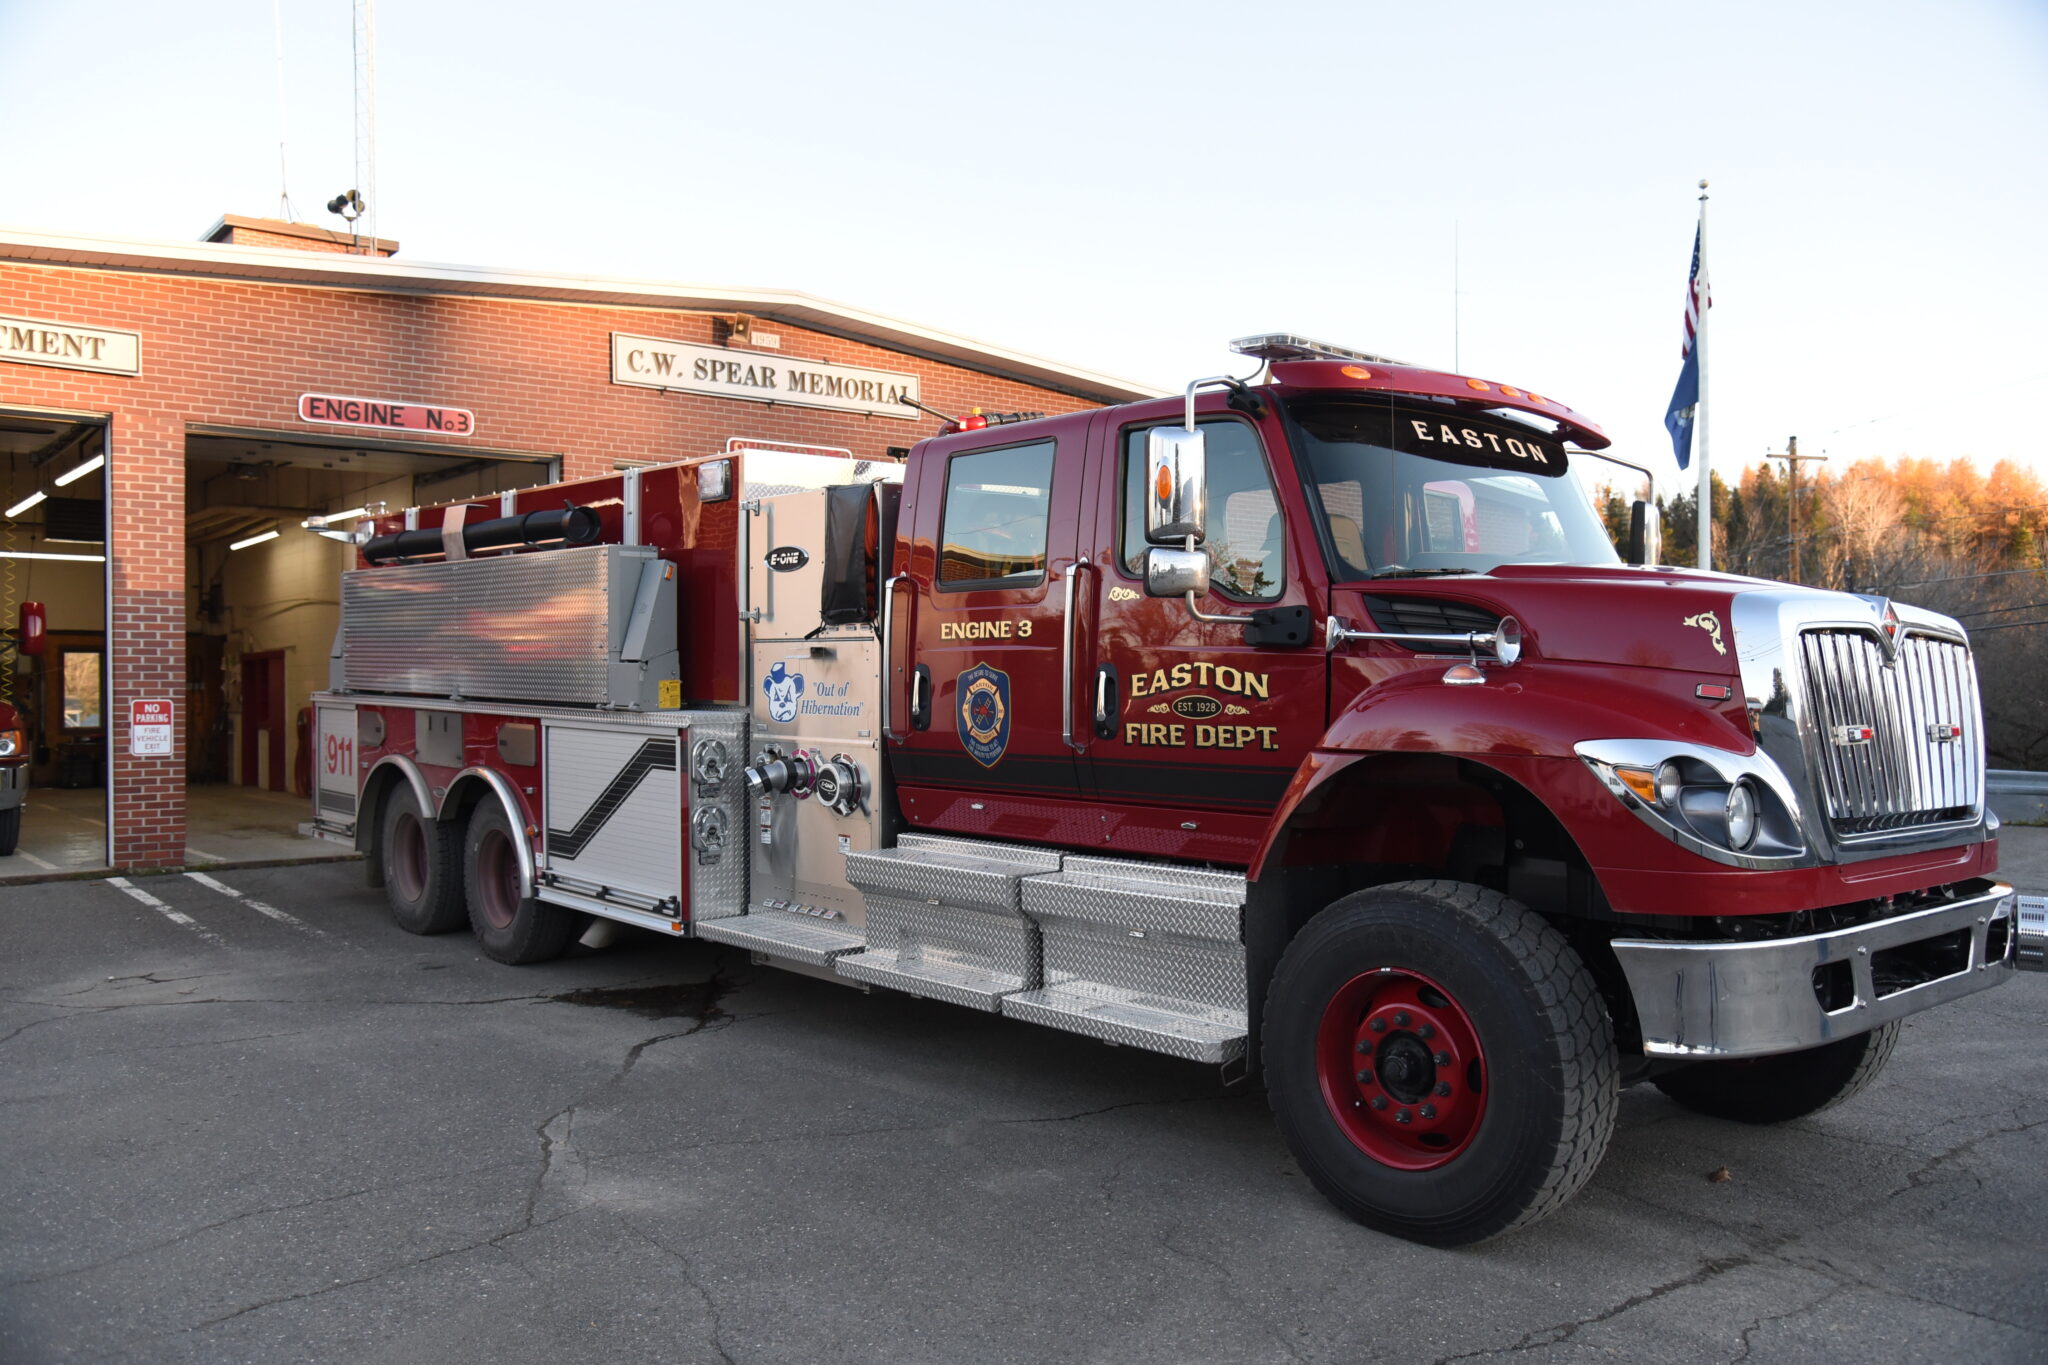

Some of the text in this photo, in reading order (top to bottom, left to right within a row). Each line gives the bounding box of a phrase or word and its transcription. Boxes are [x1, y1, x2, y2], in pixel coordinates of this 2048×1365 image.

[755, 334, 777, 347] 1959
[627, 349, 683, 378] C.W.
[693, 357, 778, 389] SPEAR
[309, 398, 405, 427] ENGINE
[1411, 420, 1549, 464] EASTON
[770, 551, 800, 566] E-ONE
[941, 620, 1033, 640] ENGINE 3
[838, 681, 850, 697] of
[1131, 661, 1269, 698] EASTON
[144, 703, 160, 713] NO
[1177, 701, 1216, 713] EST. 1928
[136, 713, 169, 723] PARKING
[1125, 722, 1279, 750] FIRE DEPT.
[327, 733, 353, 777] 911
